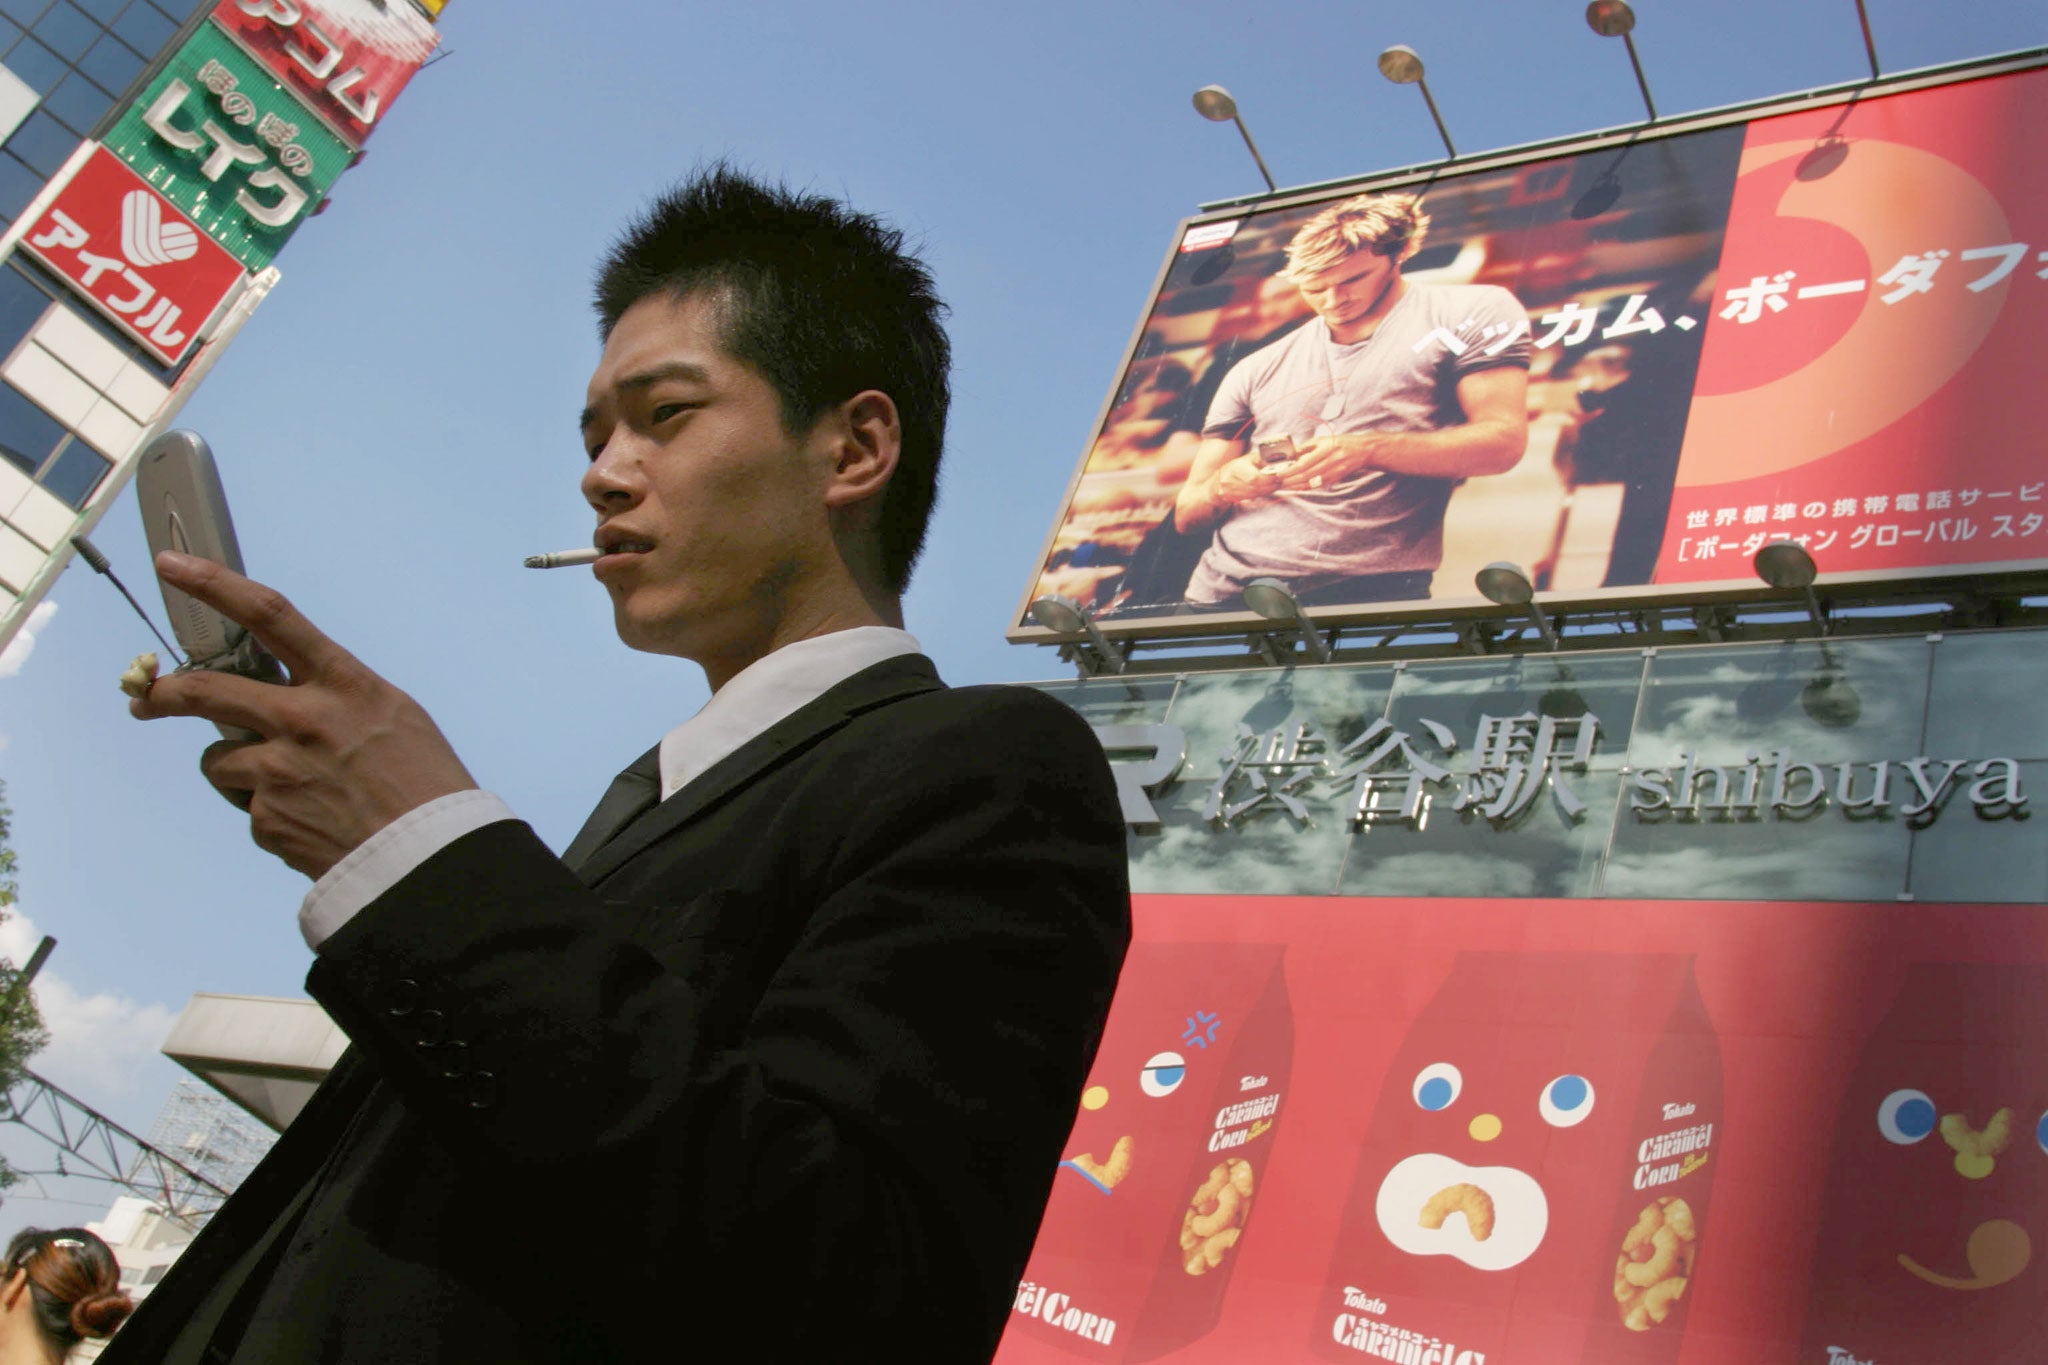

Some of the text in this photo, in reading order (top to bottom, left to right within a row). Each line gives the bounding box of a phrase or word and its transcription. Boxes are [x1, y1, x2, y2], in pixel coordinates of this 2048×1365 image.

[197, 58, 314, 177] ほのぼの
[236, 0, 380, 125] アコム
[142, 78, 309, 228] レイク
[32, 208, 186, 347] アイフル
[1412, 242, 2048, 356] ベッカム、ボーダフ
[1991, 512, 2048, 538] スタ
[1202, 711, 1600, 822] 渋谷駅
[1631, 749, 2028, 816] shibuya
[1343, 1286, 1388, 1315] Tohato
